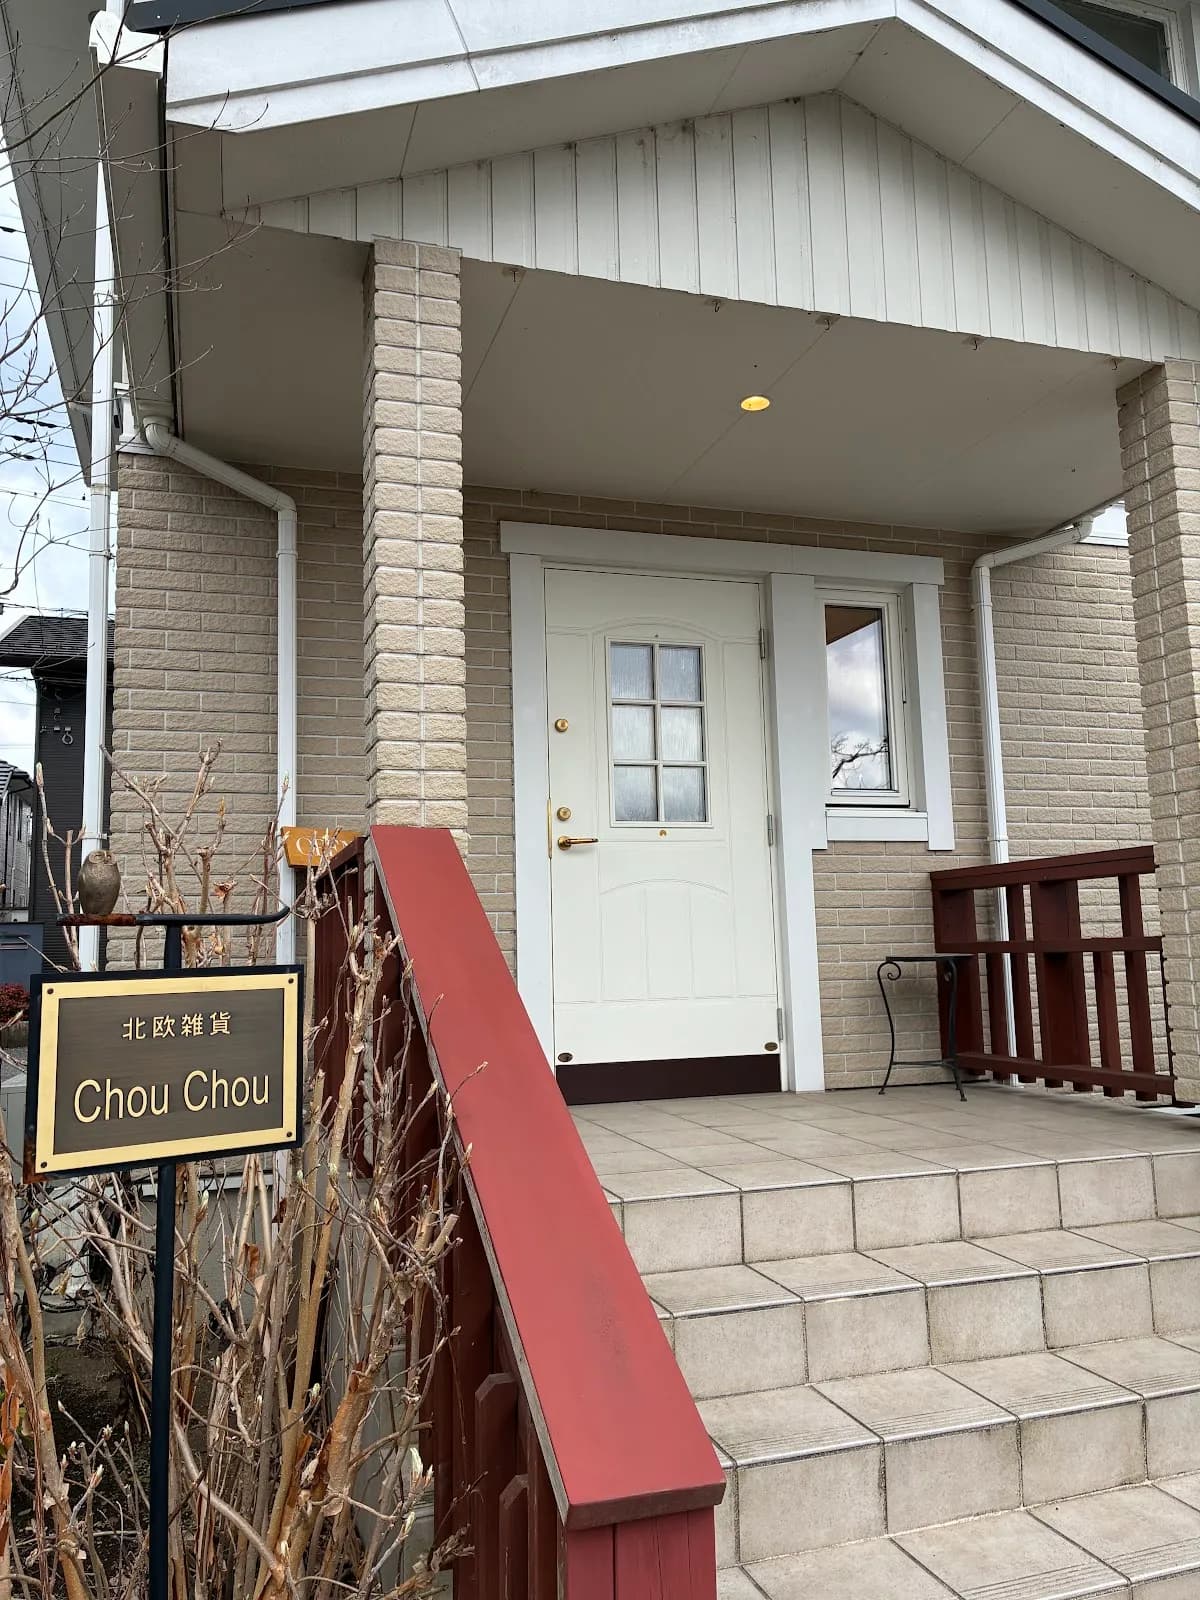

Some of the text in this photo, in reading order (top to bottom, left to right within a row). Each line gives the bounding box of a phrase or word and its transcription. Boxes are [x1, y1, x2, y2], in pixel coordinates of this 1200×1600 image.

[122, 1011, 232, 1041] 北欧雑貨
[74, 1069, 269, 1124] Chou Chou
